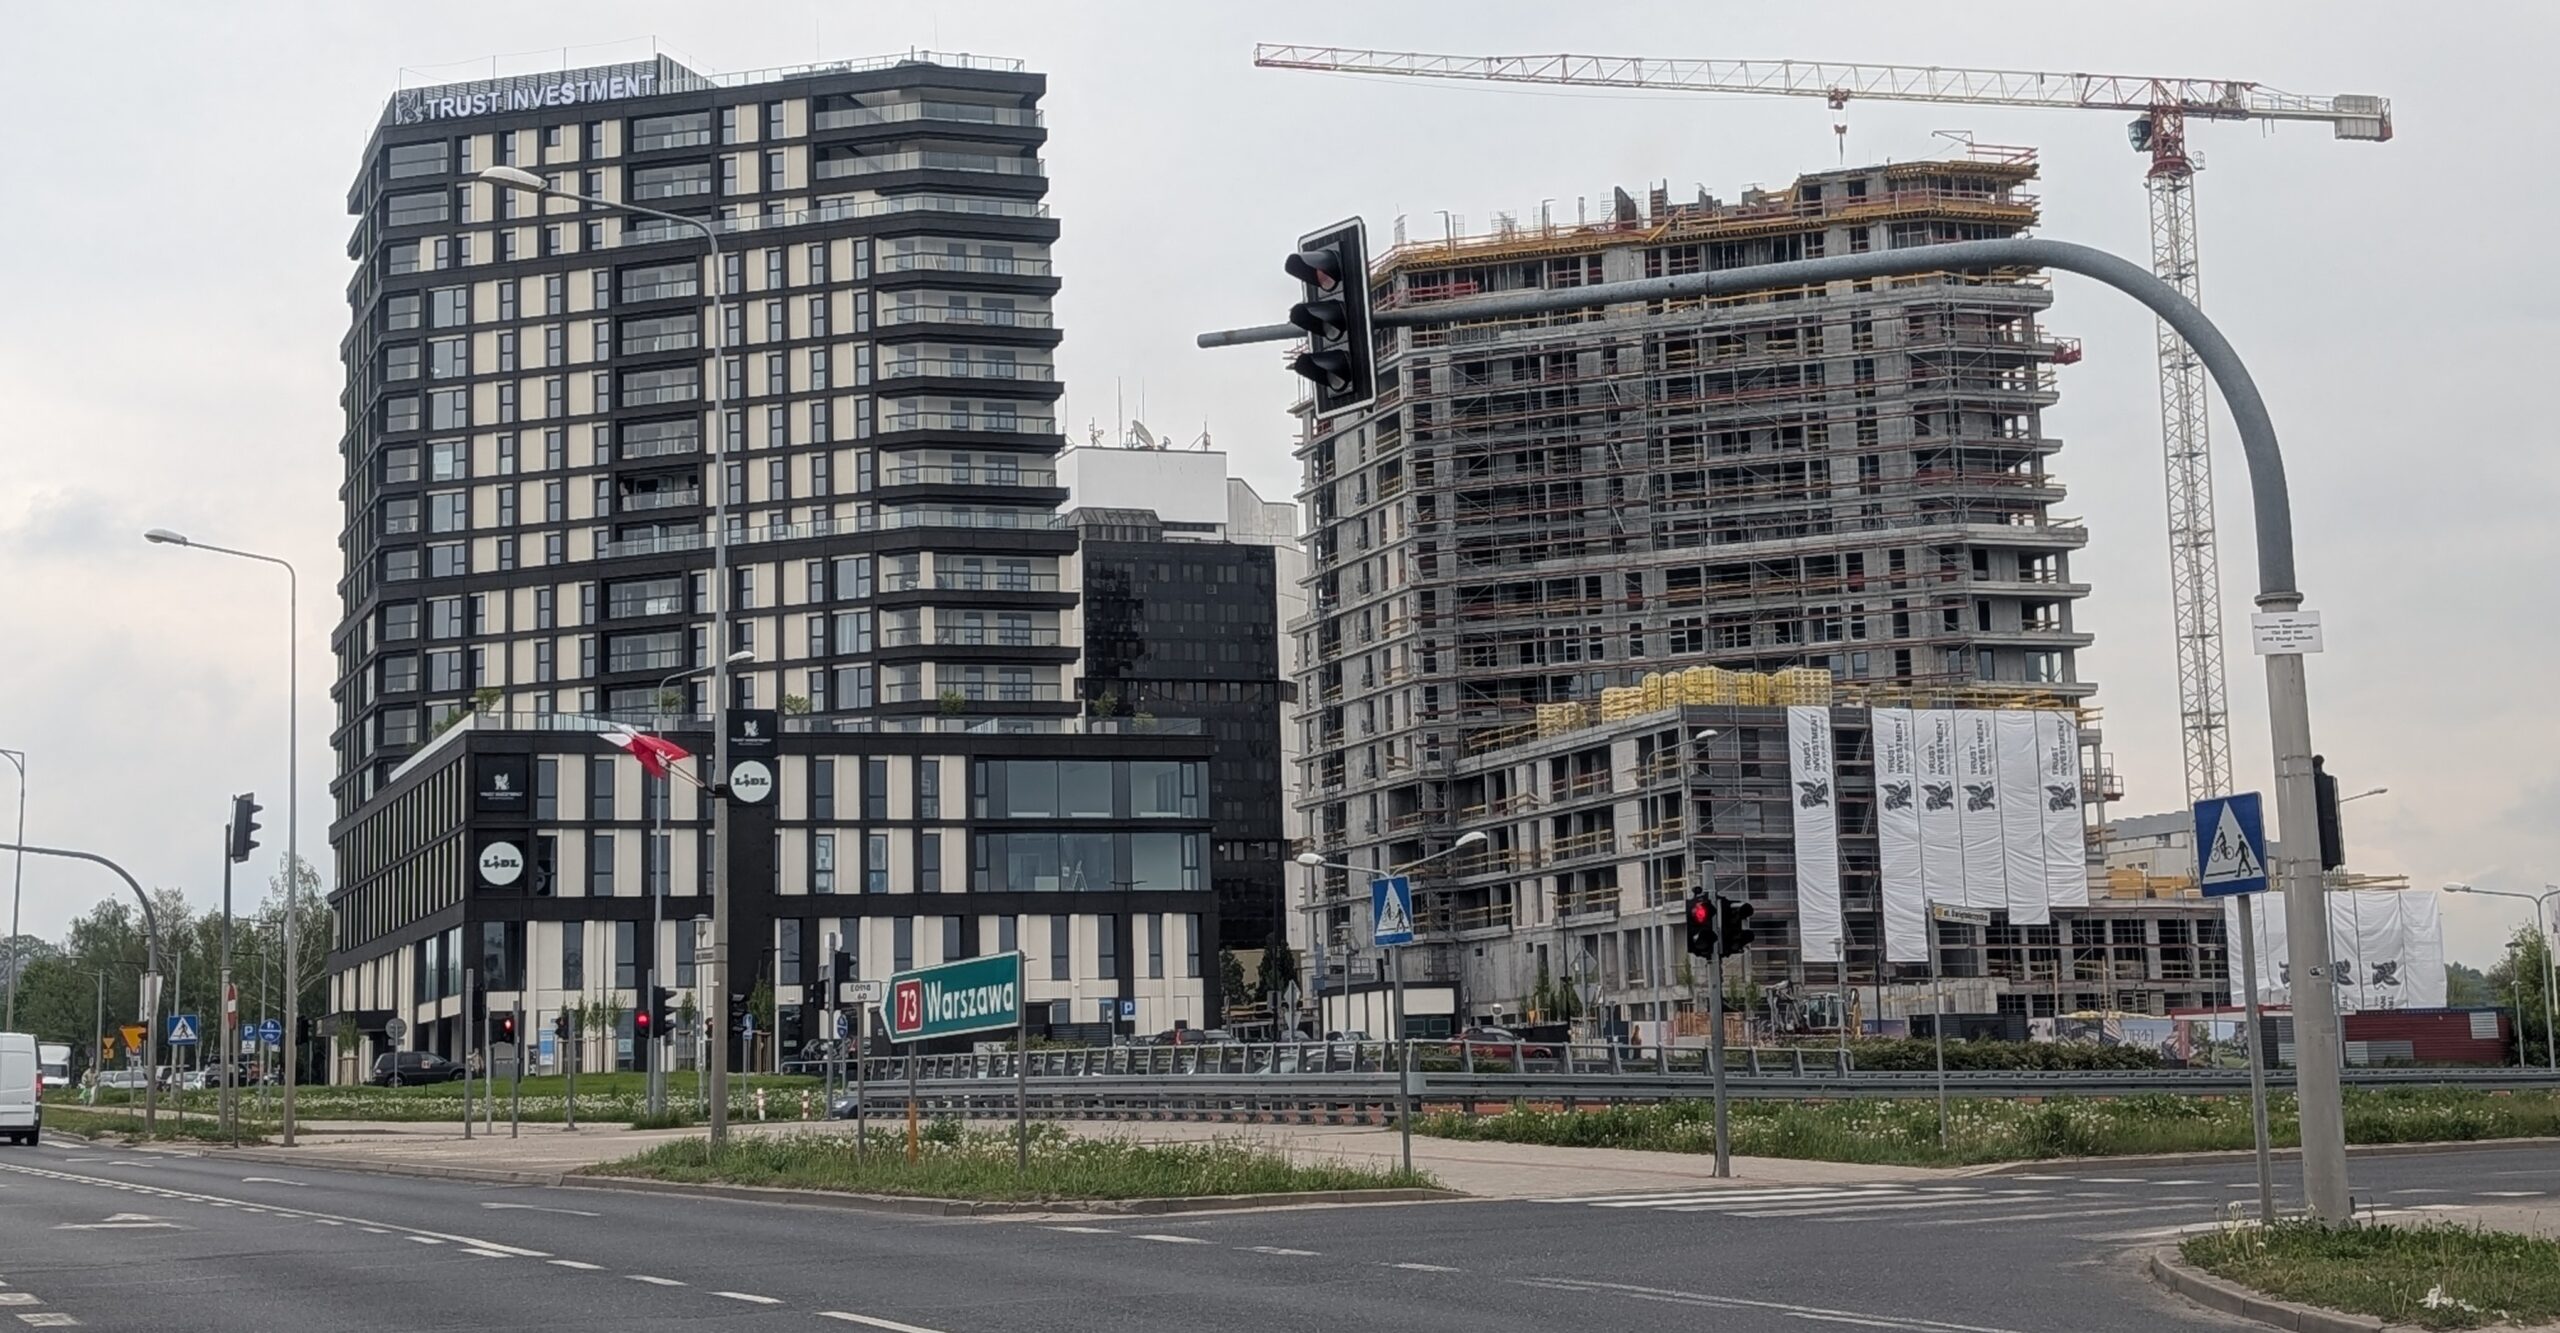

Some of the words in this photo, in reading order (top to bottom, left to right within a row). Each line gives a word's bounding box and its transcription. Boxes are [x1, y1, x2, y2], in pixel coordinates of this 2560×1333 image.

[426, 92, 501, 119] TRUST
[507, 74, 655, 111] INVESTMENT
[1803, 741, 1812, 771] TRUST
[1810, 714, 1821, 772] INVESTMENT
[1887, 744, 1896, 774] TRUST
[1894, 717, 1904, 774] INVESTMENT
[1928, 745, 1936, 775] TRUST
[1936, 717, 1945, 775] INVESTMENT
[1969, 745, 1978, 775] TRUST
[1976, 718, 1987, 776] INVESTMENT
[2051, 746, 2060, 776] TRUST
[2057, 720, 2067, 776] INVESTMENT
[901, 989, 917, 1023] 73
[925, 980, 1014, 1023] Warszawa
[1124, 1001, 1133, 1014] P
[244, 1025, 254, 1037] P
